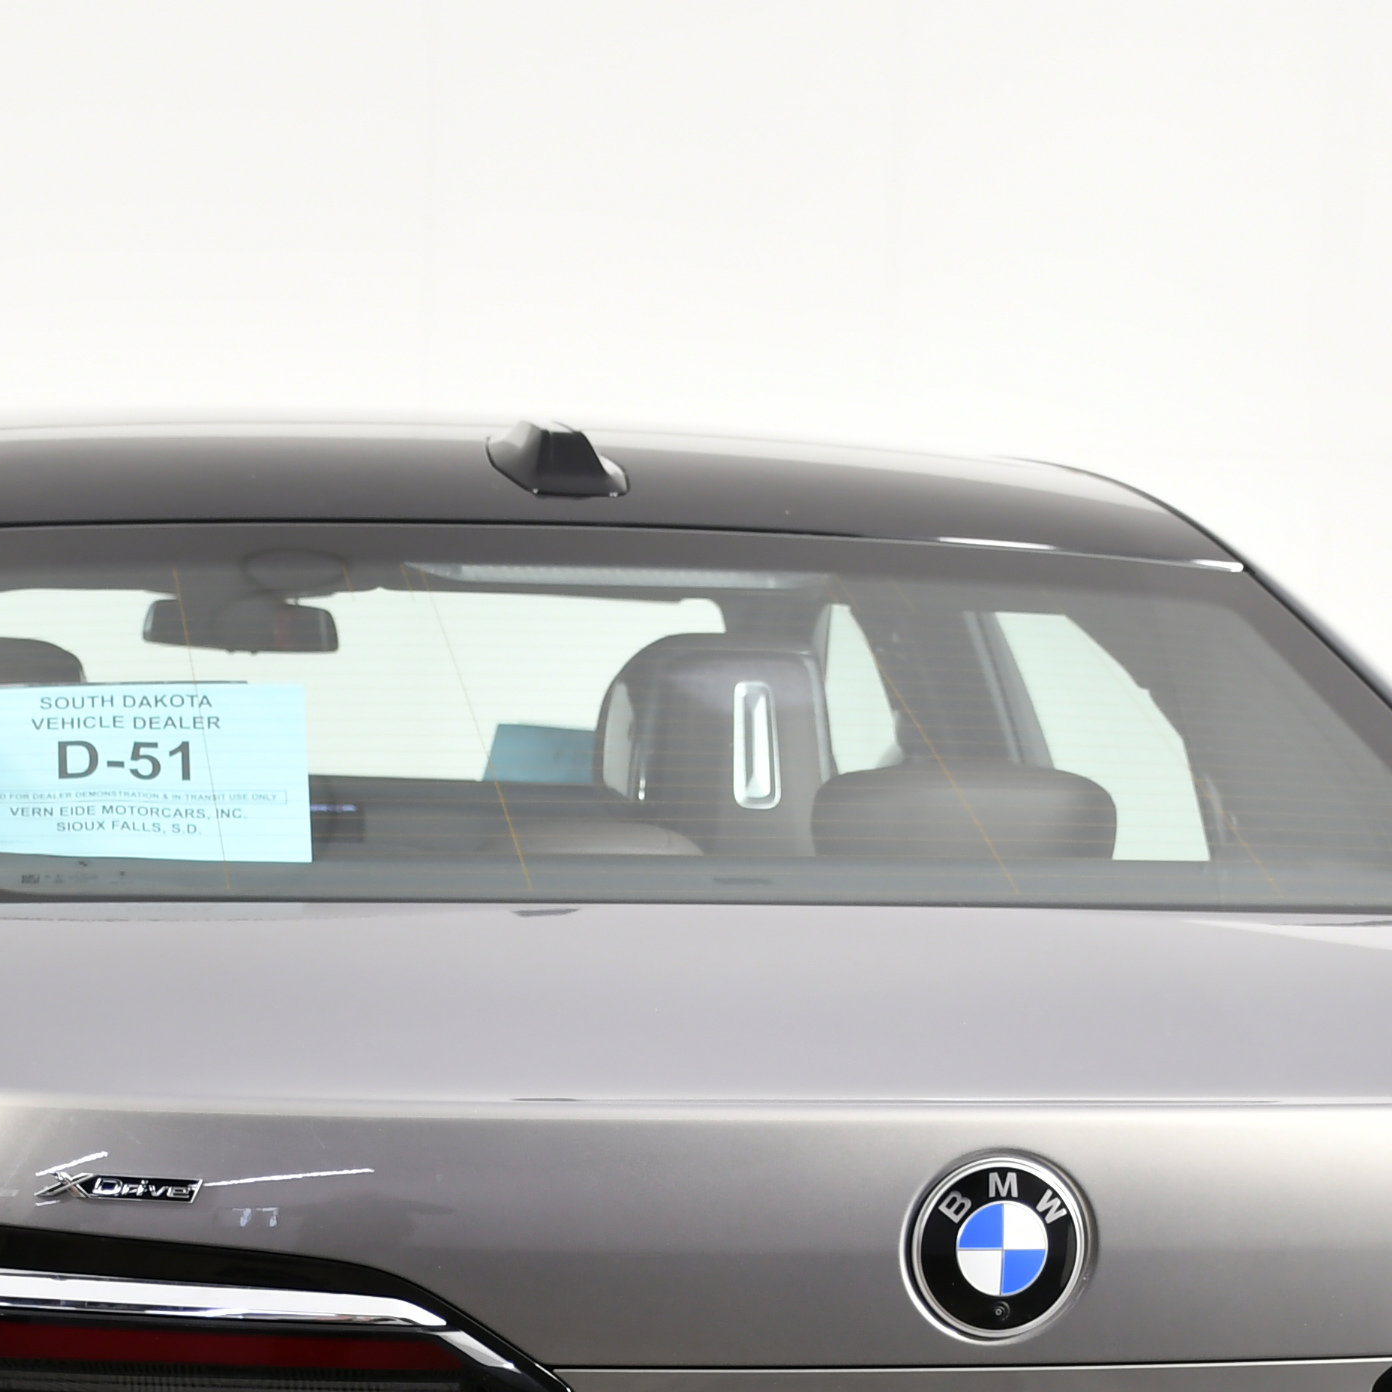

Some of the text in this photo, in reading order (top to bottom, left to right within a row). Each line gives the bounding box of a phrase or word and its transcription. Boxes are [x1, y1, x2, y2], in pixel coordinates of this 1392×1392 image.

[40, 694, 213, 710] SOUTH DAKOTA
[31, 715, 221, 731] VEHICLE DEALER
[57, 740, 191, 781] D-51
[32, 792, 72, 800] DEALER
[75, 790, 159, 800] DEMONSTRATION
[229, 793, 248, 801] USE
[251, 793, 277, 801] ONLY
[10, 804, 248, 819] VERN EIDE MOTORCARS, INC.
[57, 820, 202, 835] SIOUX FALLS, S.D.
[938, 1172, 1067, 1224] BMW
